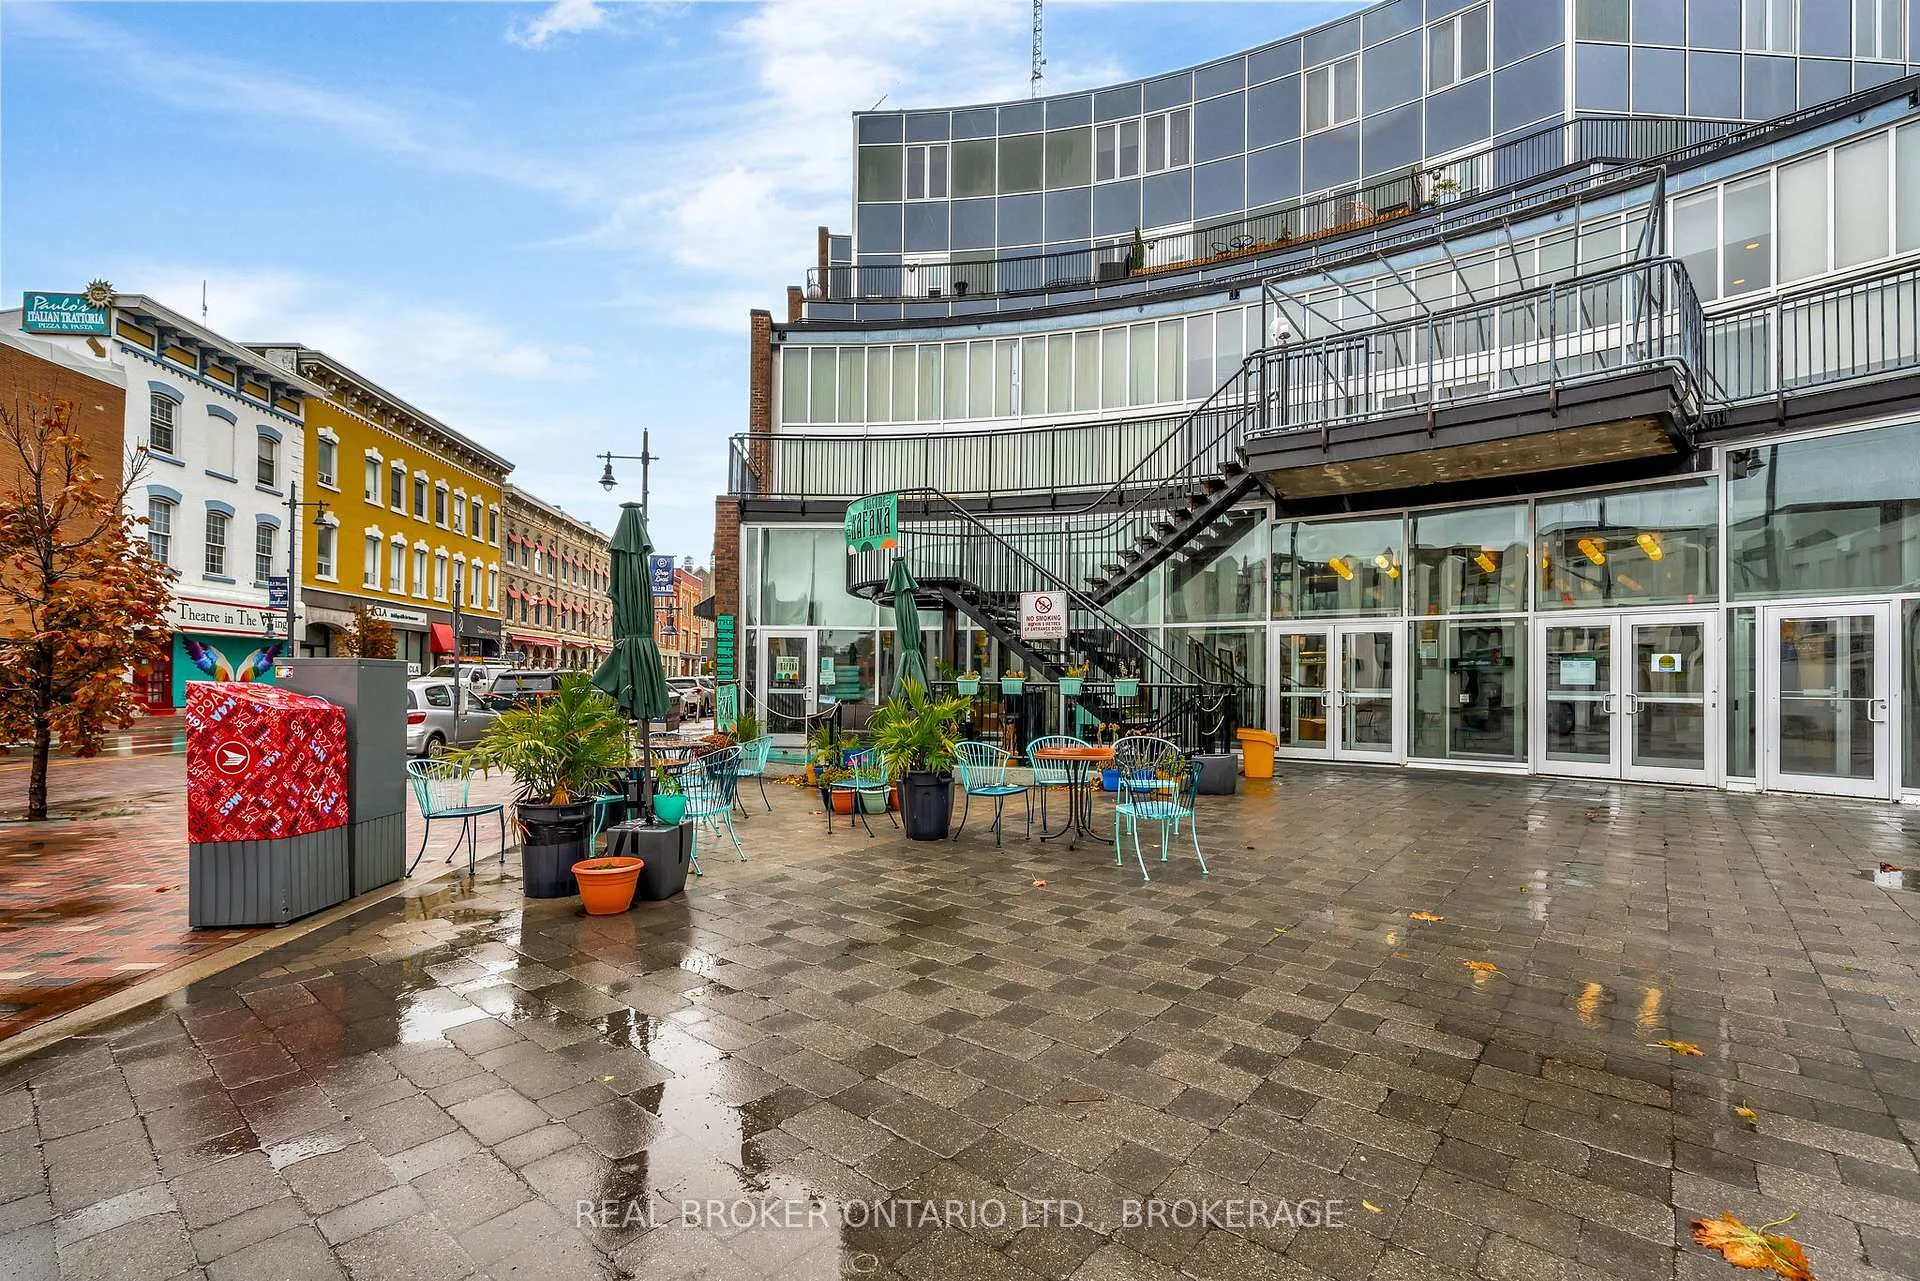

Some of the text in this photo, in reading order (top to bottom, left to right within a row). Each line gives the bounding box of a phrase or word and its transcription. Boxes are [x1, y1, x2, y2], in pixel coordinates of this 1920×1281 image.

[33, 296, 90, 312] Paulo's
[27, 310, 104, 325] ITALIAN TRATTORIA
[177, 602, 220, 624] Theatre
[224, 611, 234, 625] in
[237, 609, 257, 626] The
[1036, 614, 1062, 622] SMOKING
[195, 692, 224, 718] P9A
[210, 697, 236, 721] K4A
[185, 712, 207, 733] H9X
[234, 720, 248, 731] J5T
[238, 708, 254, 726] V7J
[291, 720, 306, 740] G5N
[314, 729, 332, 752] B2Z
[264, 751, 280, 766] K4A
[309, 740, 326, 762] S4N
[190, 766, 204, 777] J5T
[193, 755, 209, 772] V7J
[324, 766, 340, 785] E4P
[191, 793, 212, 812] G3N
[219, 792, 243, 816] M6S
[246, 803, 262, 820] V7J
[323, 791, 338, 813] K4A
[242, 813, 256, 824] J5T
